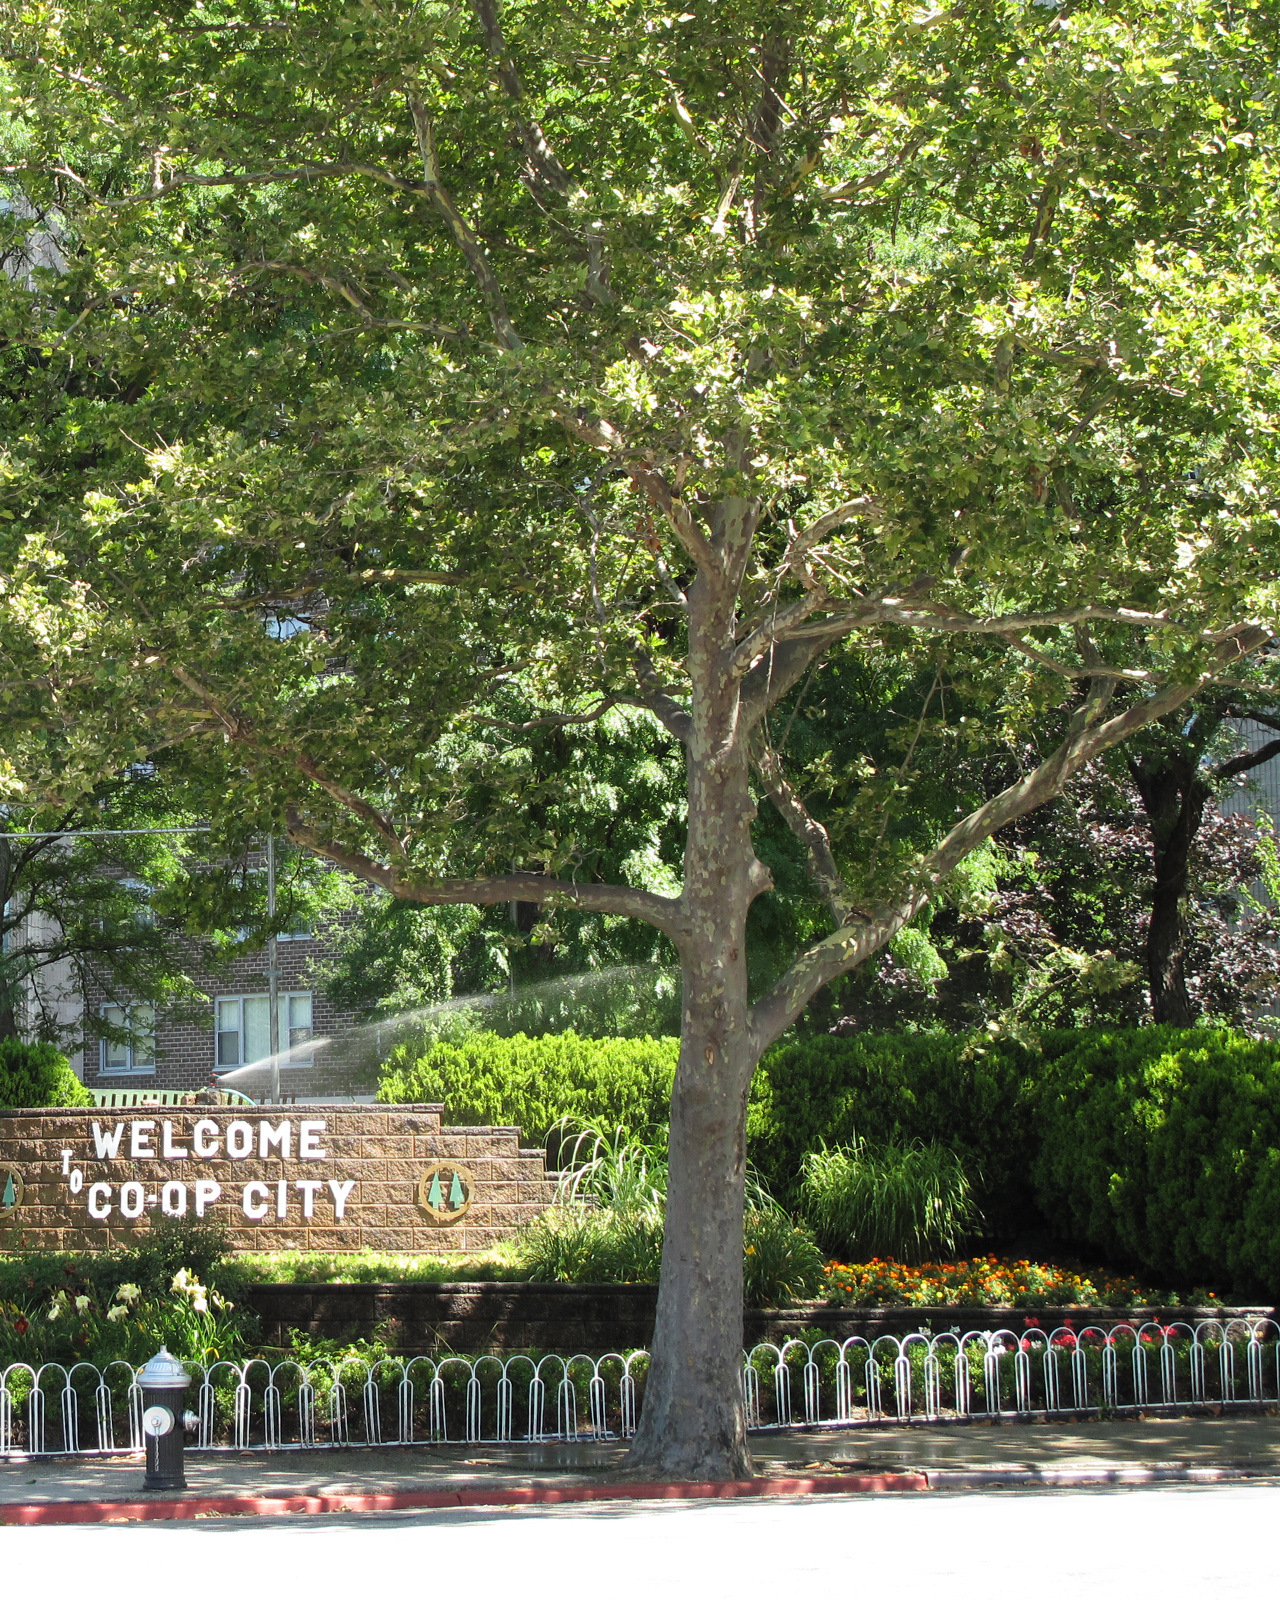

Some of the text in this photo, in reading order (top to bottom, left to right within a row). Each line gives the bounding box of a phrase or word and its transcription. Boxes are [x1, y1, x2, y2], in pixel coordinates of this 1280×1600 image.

[92, 1120, 326, 1159] WELCOME
[61, 1150, 83, 1194] TO
[88, 1179, 355, 1219] CO-OP CITY
